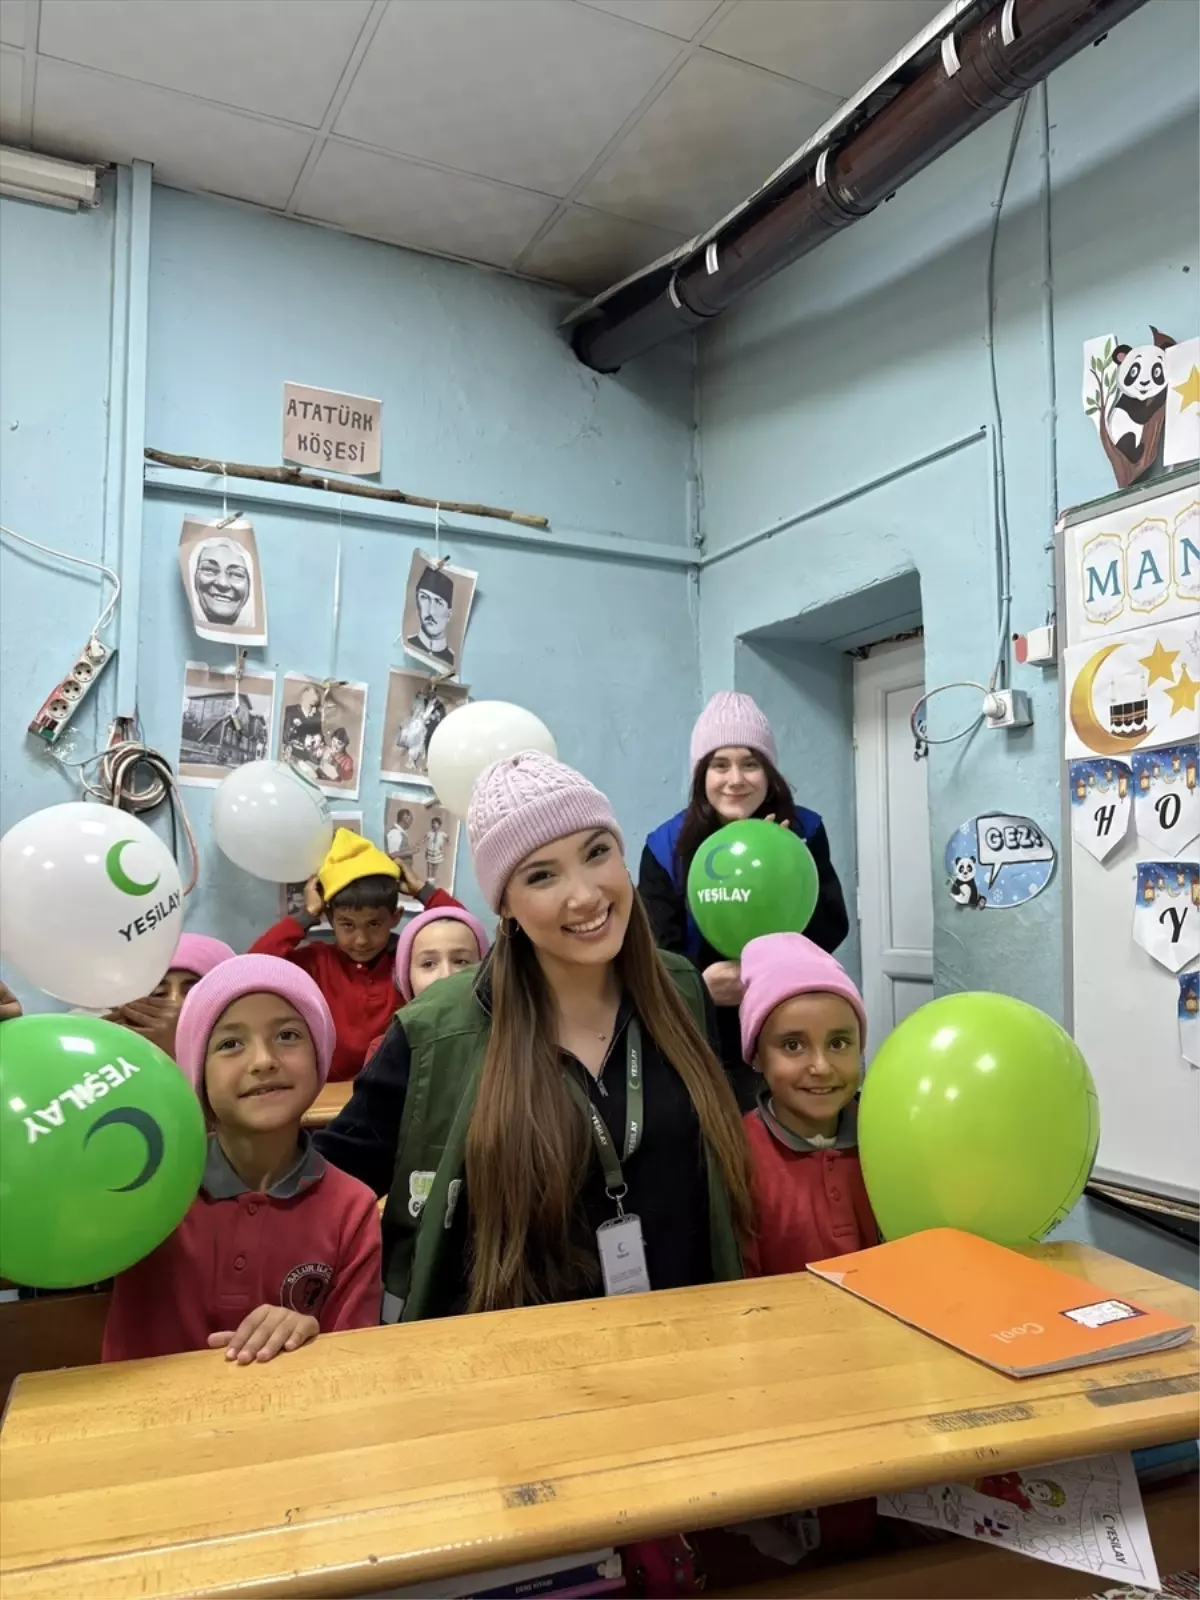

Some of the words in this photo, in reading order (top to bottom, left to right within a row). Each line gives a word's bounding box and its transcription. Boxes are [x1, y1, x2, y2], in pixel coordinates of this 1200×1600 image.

[286, 398, 373, 432] ATATÜRK
[297, 432, 366, 463] KÖŞESİ
[990, 1322, 1045, 1344] Cool
